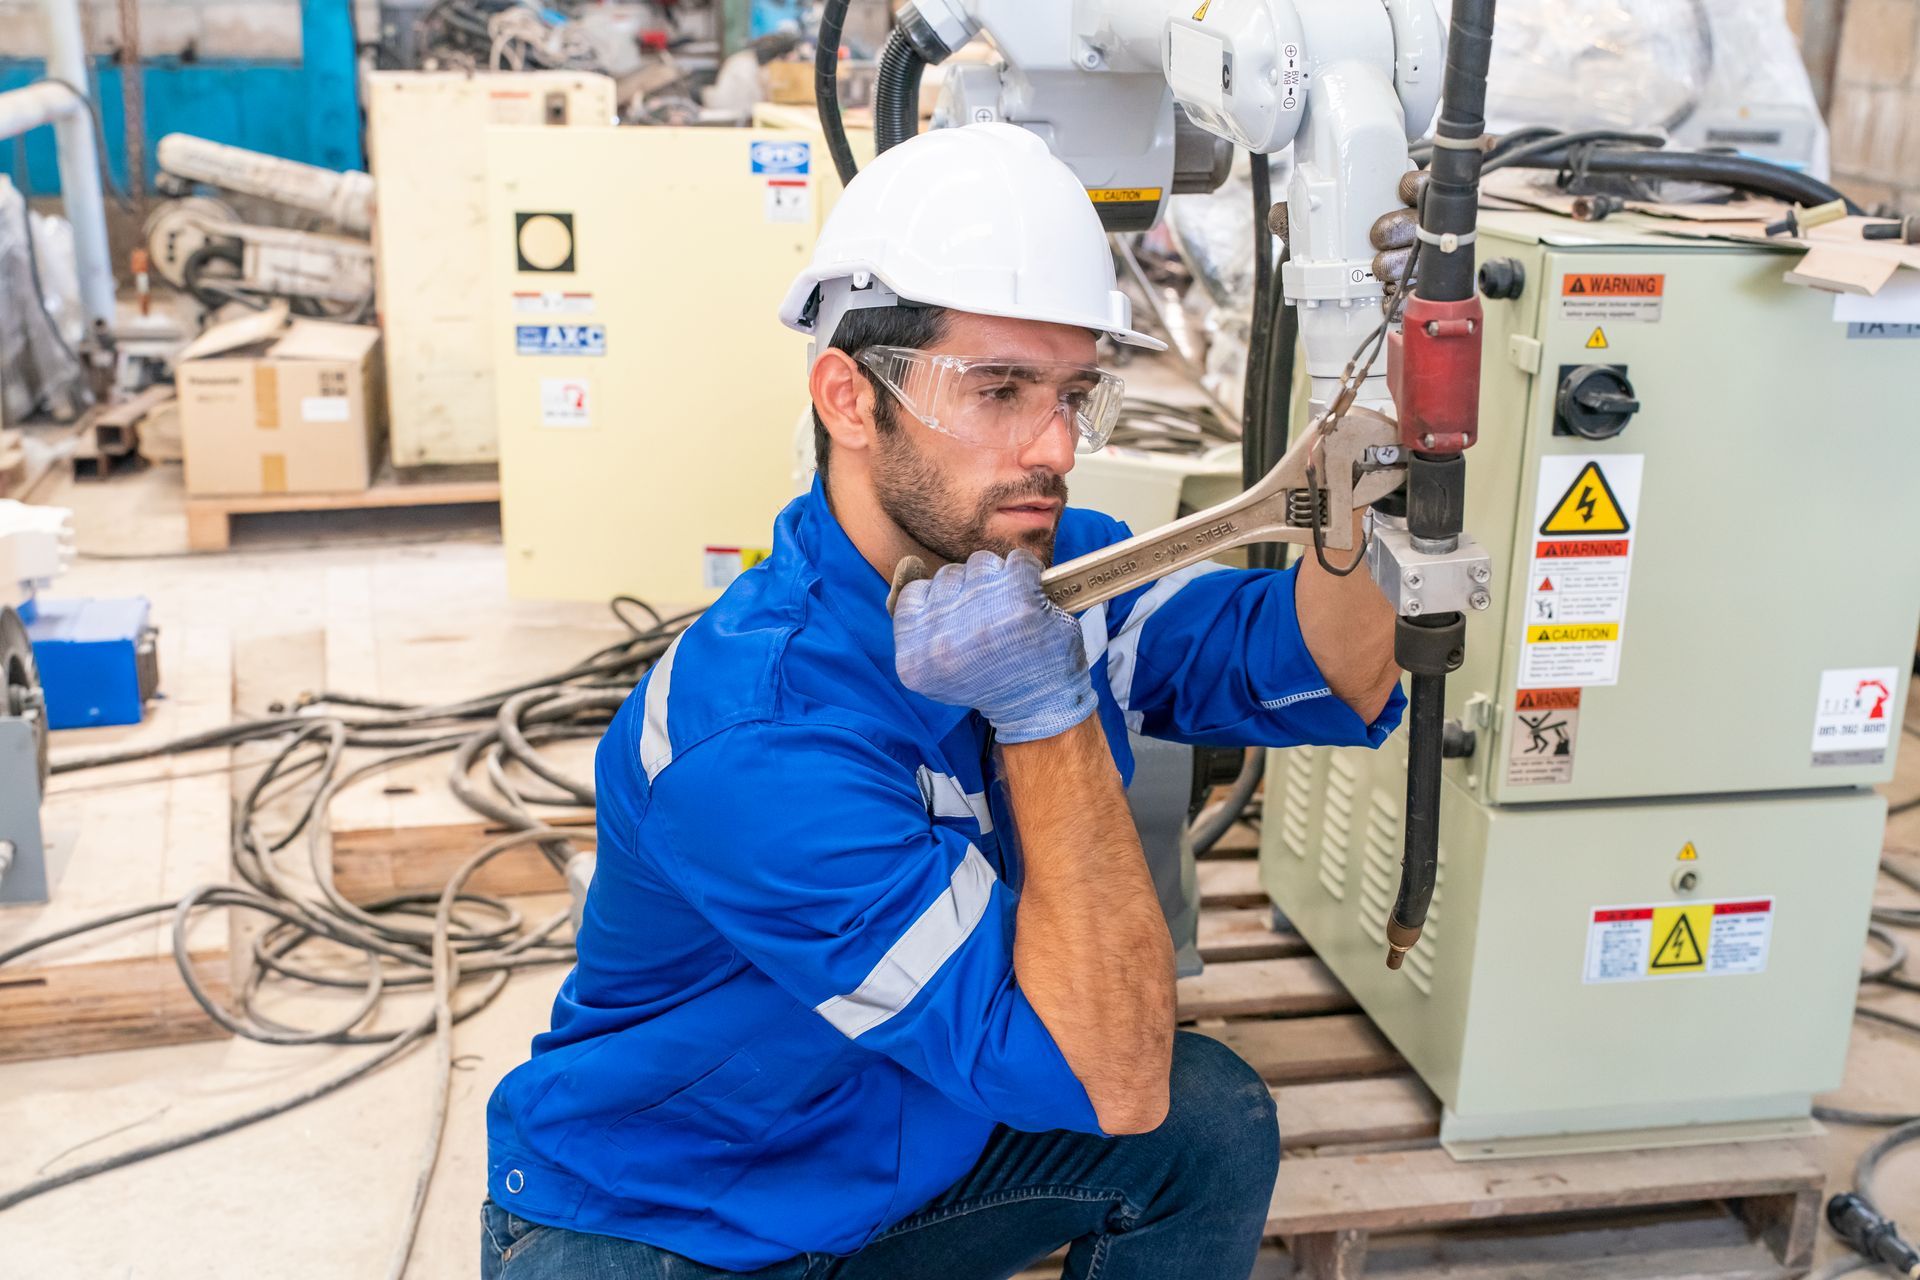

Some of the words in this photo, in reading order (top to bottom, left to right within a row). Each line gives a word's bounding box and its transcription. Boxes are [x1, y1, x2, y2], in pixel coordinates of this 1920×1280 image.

[1103, 191, 1141, 201] CAUTION
[1590, 277, 1656, 293] WARNING
[1087, 560, 1139, 589] FORGED
[1194, 520, 1239, 546] STEEL
[1559, 542, 1623, 556] WARNING
[1551, 627, 1610, 641] CAUTION
[1536, 691, 1580, 708] WARNING
